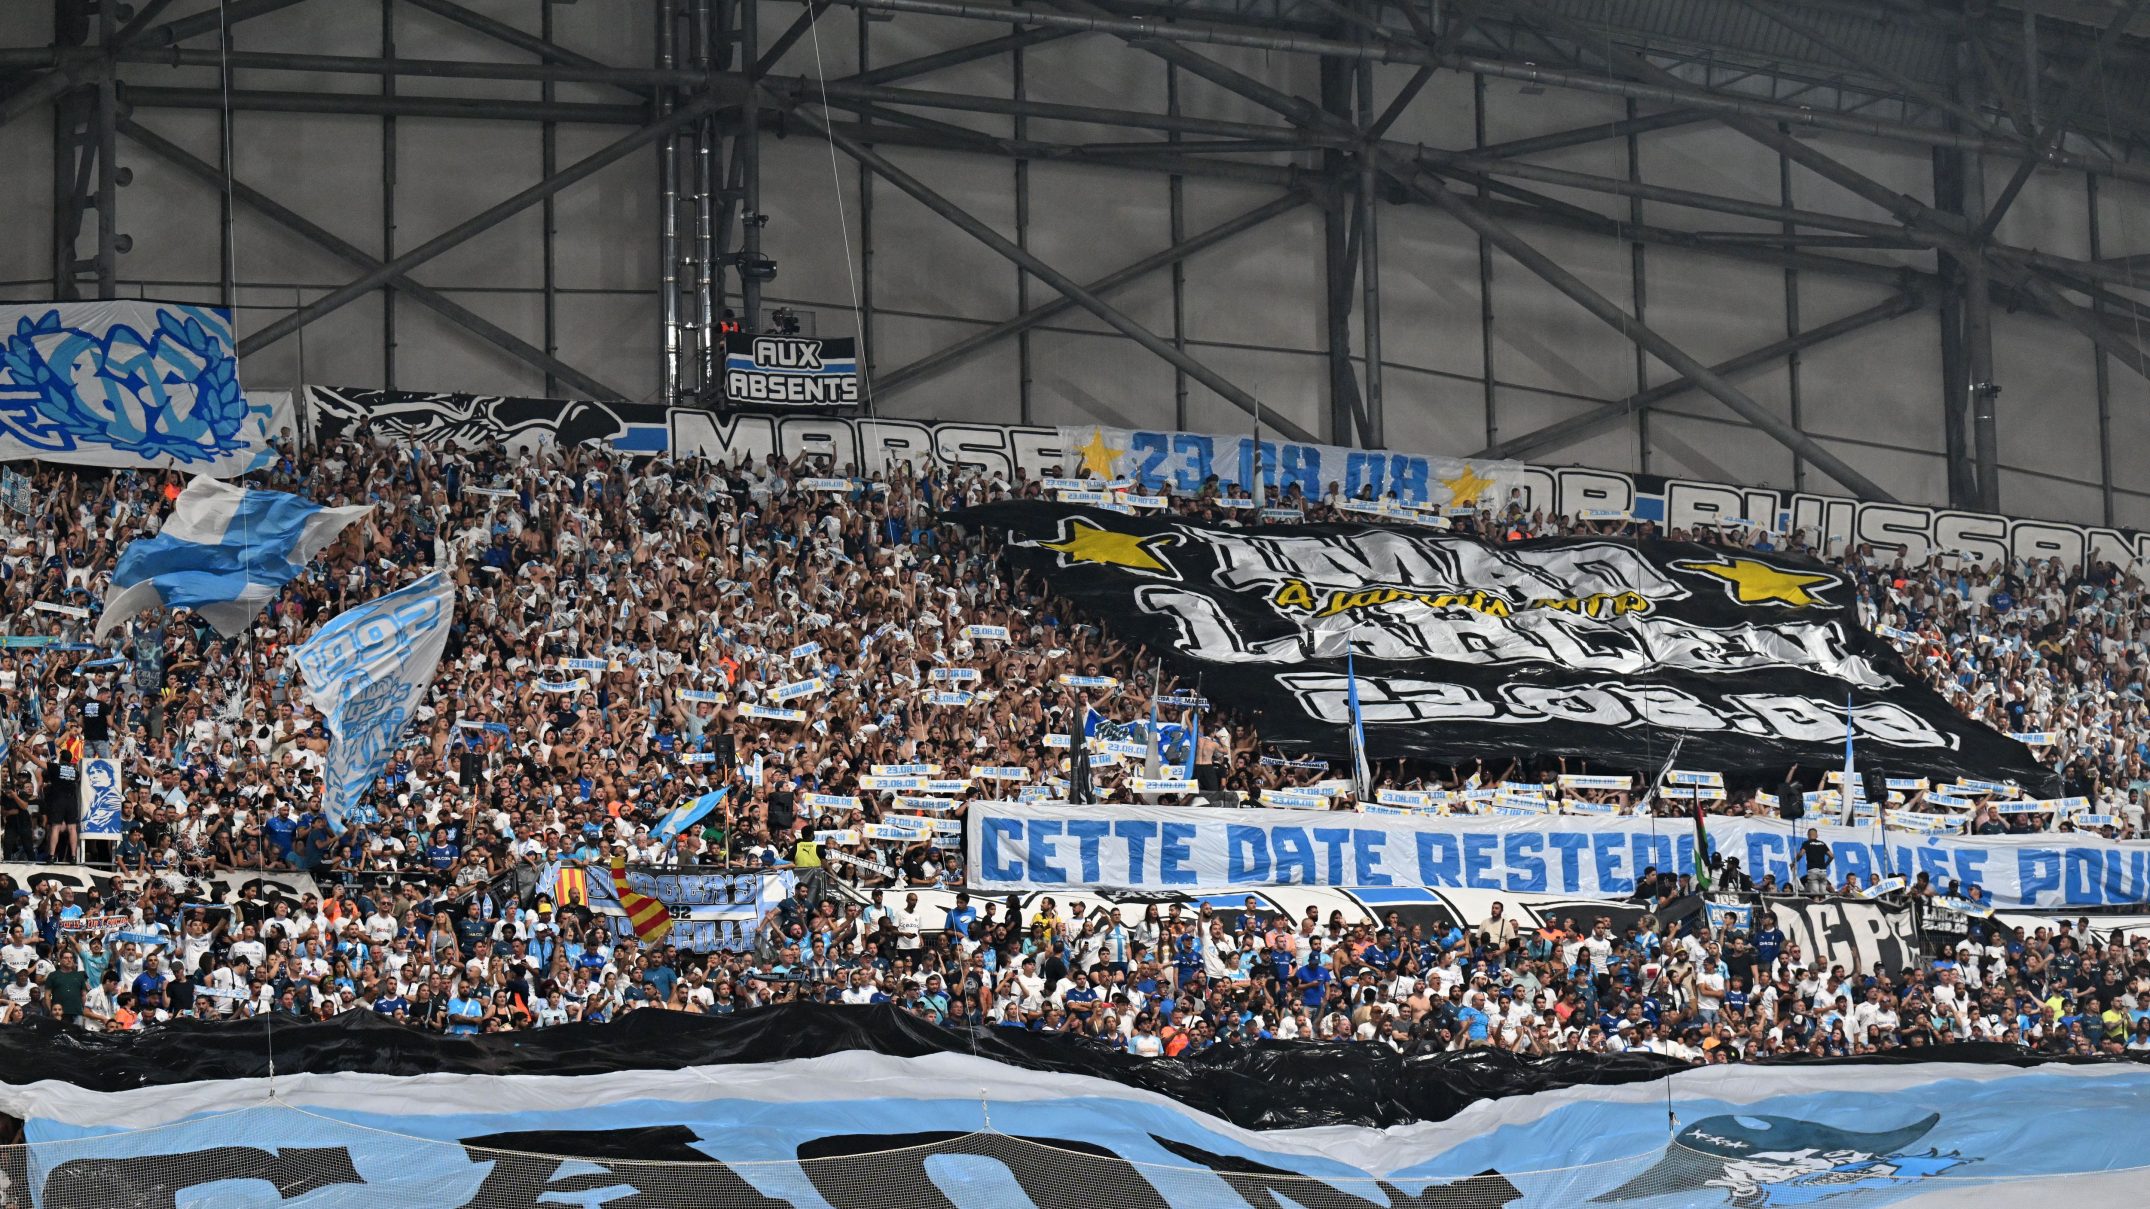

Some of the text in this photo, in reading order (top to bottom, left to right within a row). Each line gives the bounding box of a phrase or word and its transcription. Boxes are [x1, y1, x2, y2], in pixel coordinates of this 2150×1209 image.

[757, 340, 821, 369] AUX
[727, 373, 858, 402] ABSENTS
[300, 596, 441, 691] 1992
[886, 765, 927, 774] 23.08.08
[877, 780, 917, 788] 23.08.08
[815, 796, 852, 806] 23.08.08
[1383, 793, 1419, 803] 23.08.08
[1999, 803, 2037, 811] 23.08.08
[2079, 816, 2112, 824] 23.08.08
[982, 816, 1198, 885] CETTE
[1227, 824, 1393, 887] DATE
[1746, 831, 1990, 906] GAVÉE
[2017, 847, 2150, 905] POU
[587, 866, 757, 905] DDGER'S
